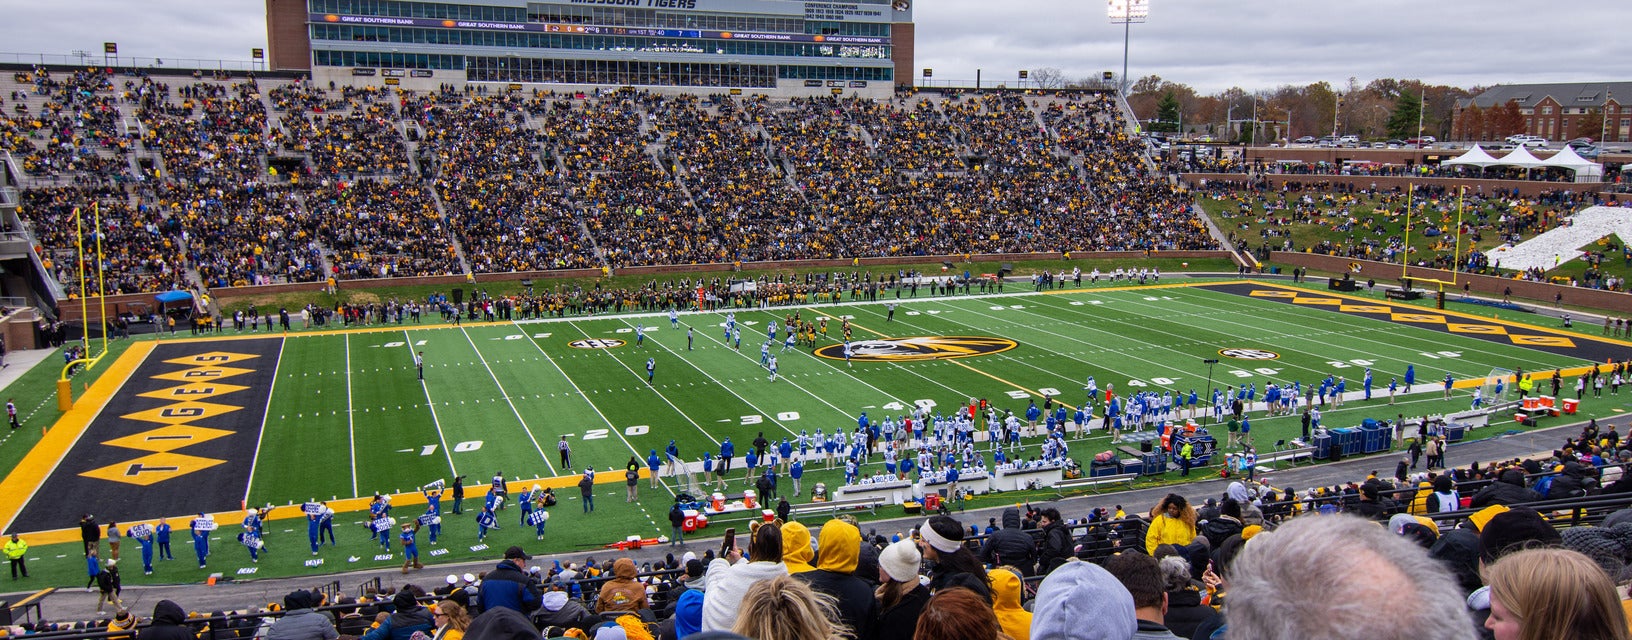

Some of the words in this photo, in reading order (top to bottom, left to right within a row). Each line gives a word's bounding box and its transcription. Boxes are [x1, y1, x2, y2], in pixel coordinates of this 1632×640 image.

[648, 0, 696, 9] TIGERS
[124, 354, 231, 476] TIGERS
[740, 411, 801, 425] 30
[133, 523, 146, 532] GET
[685, 518, 694, 528] G
